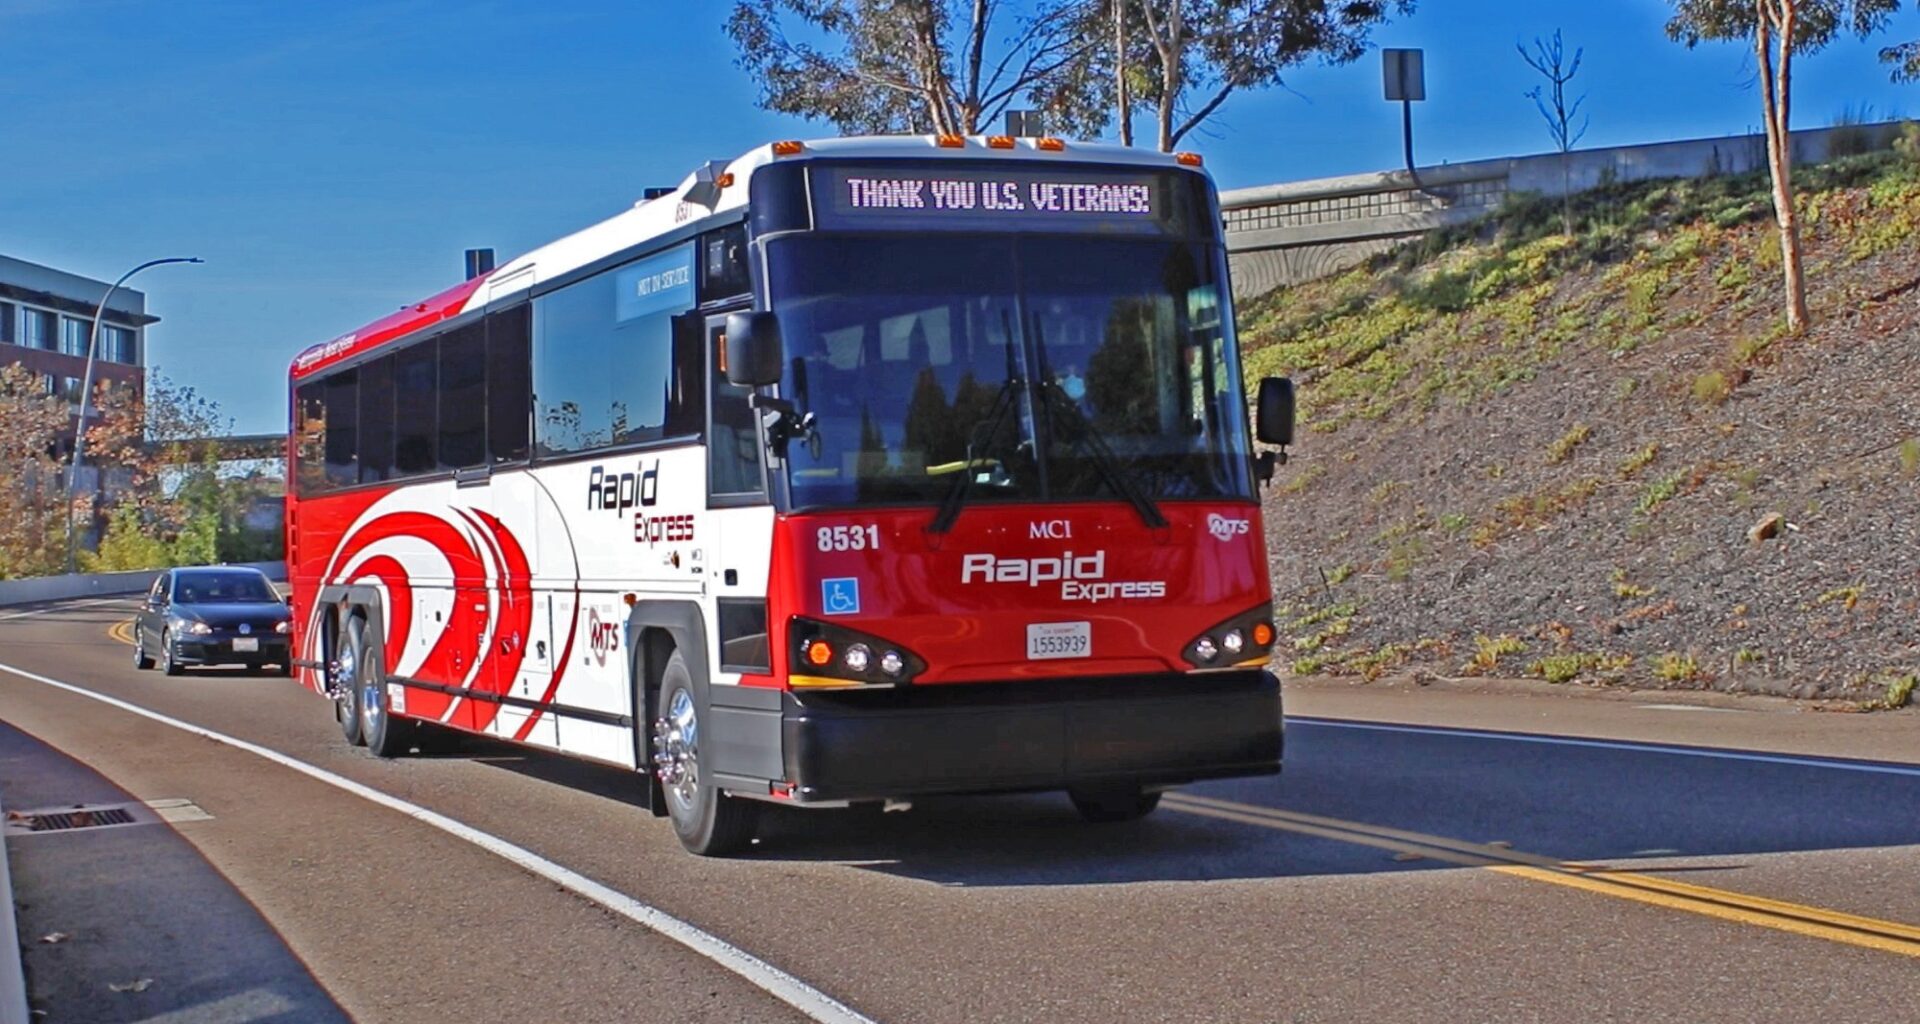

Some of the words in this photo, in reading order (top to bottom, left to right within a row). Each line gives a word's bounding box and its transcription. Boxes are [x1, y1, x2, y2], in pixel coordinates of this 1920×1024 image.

[847, 178, 925, 208] THANK
[930, 180, 976, 209] YOU
[981, 182, 1025, 210] U.S.
[1030, 183, 1151, 213] VETERANS!
[588, 458, 660, 518] Rapid
[634, 512, 695, 550] Express
[817, 524, 879, 552] 8531
[1029, 520, 1072, 539] MCI
[1209, 518, 1249, 536] MTS
[961, 550, 1105, 587] Rapid
[1061, 581, 1166, 603] Express
[590, 622, 619, 651] MTS
[1032, 635, 1087, 654] 1553939
